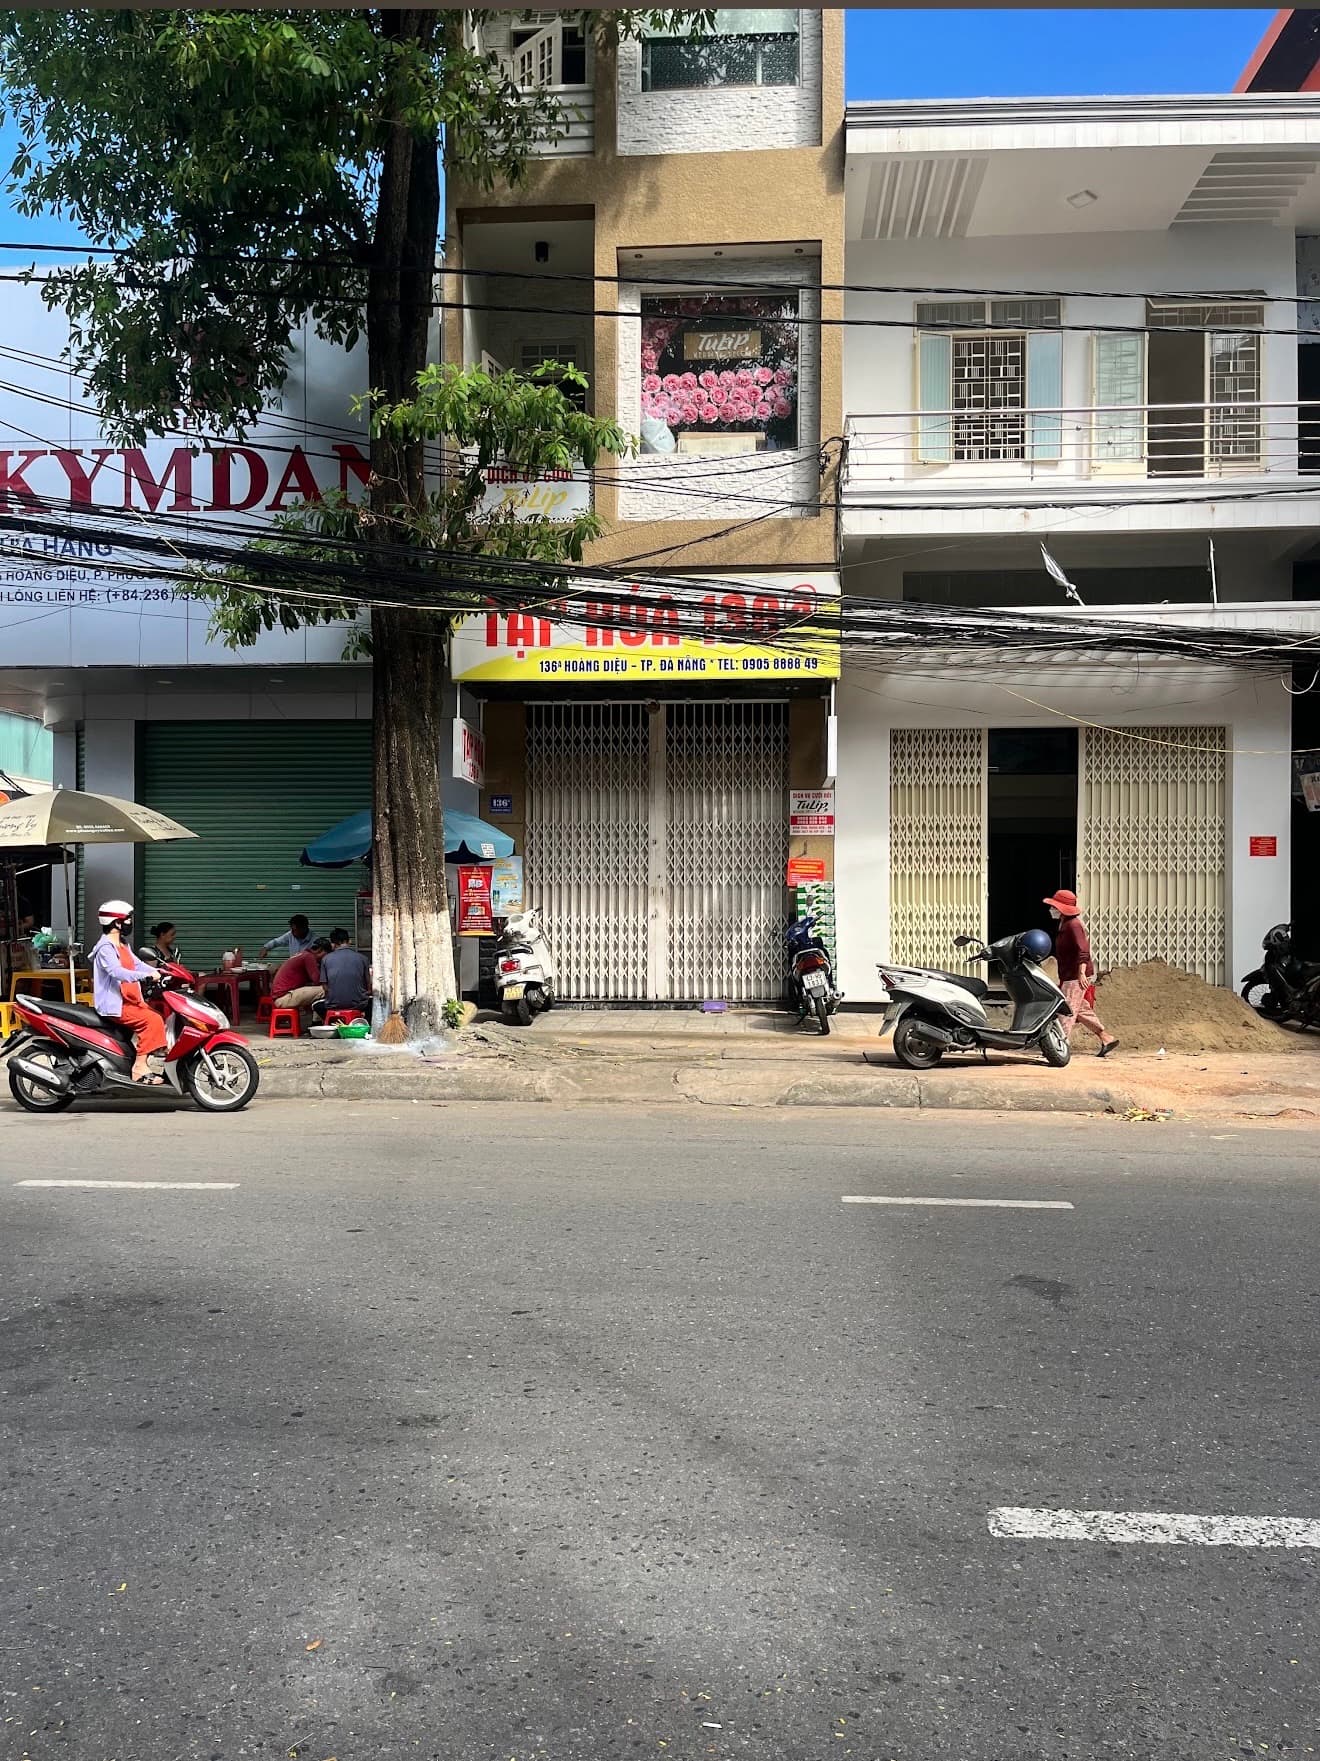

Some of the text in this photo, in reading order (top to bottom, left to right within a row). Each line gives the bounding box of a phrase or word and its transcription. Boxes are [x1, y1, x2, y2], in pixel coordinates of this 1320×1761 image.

[105, 588, 175, 603] (+84.236)
[564, 657, 600, 672] HOÀNG
[603, 657, 627, 675] DIỆU
[640, 659, 656, 671] TP.
[718, 658, 739, 671] TEL:
[742, 657, 770, 670] 0905
[804, 657, 818, 669] 49
